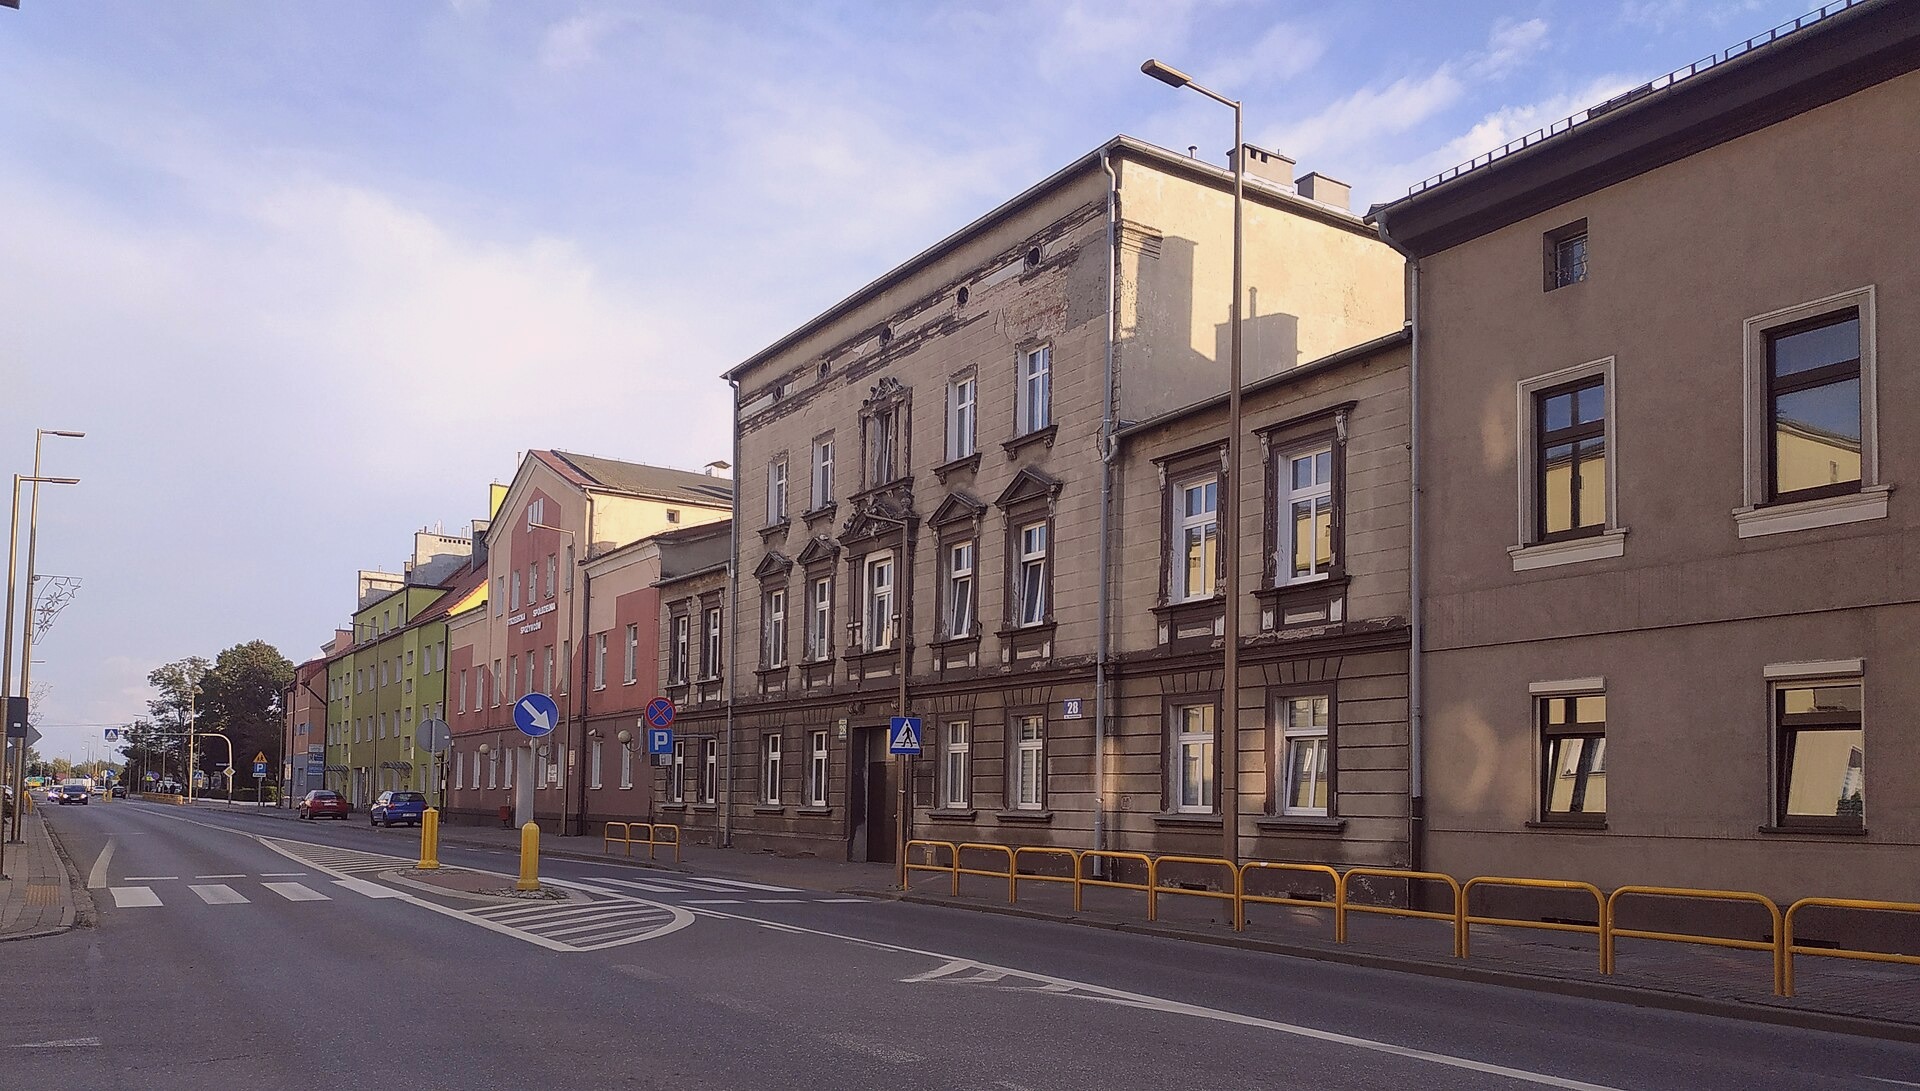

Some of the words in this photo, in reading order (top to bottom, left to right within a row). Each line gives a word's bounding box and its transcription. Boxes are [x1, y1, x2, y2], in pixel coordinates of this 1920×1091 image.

[1067, 701, 1079, 714] 28
[839, 724, 847, 735] 28
[654, 731, 668, 751] P
[256, 763, 264, 772] P
